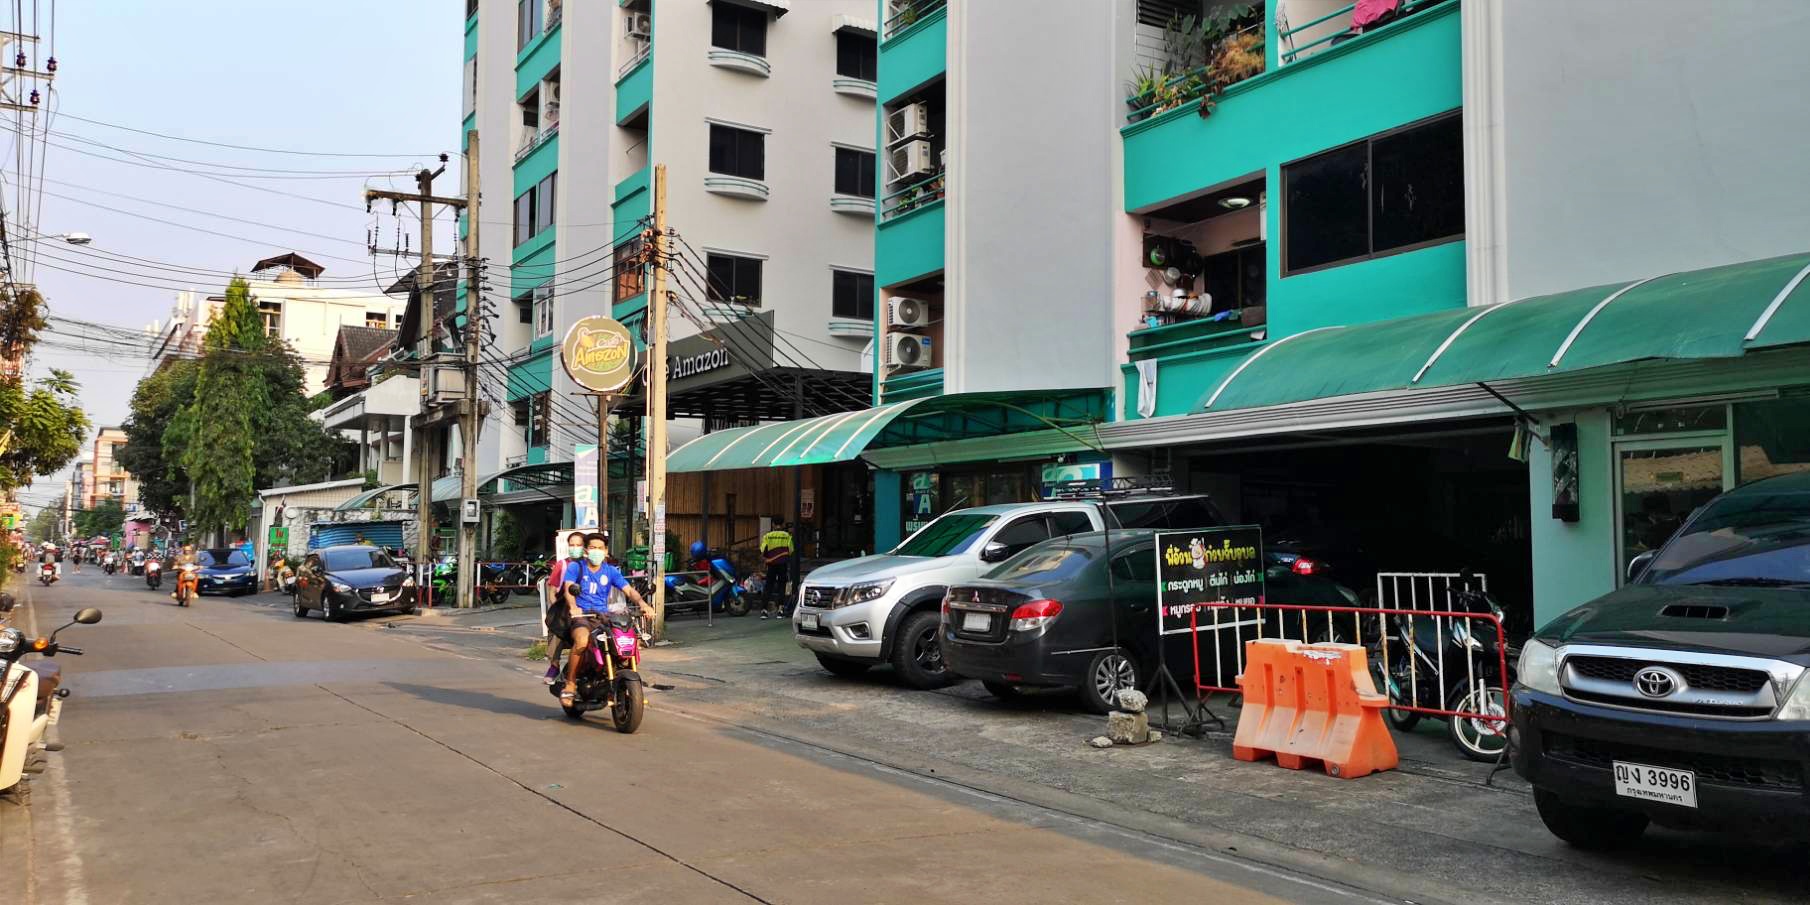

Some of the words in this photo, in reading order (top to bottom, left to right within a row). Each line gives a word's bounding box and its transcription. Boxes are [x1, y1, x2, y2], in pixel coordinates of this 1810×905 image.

[672, 348, 729, 380] Amazon
[1167, 577, 1204, 593] กระดูกหมู
[1233, 568, 1256, 584] น่องไก่
[1615, 764, 1642, 785] ญง
[1648, 769, 1690, 792] 3996
